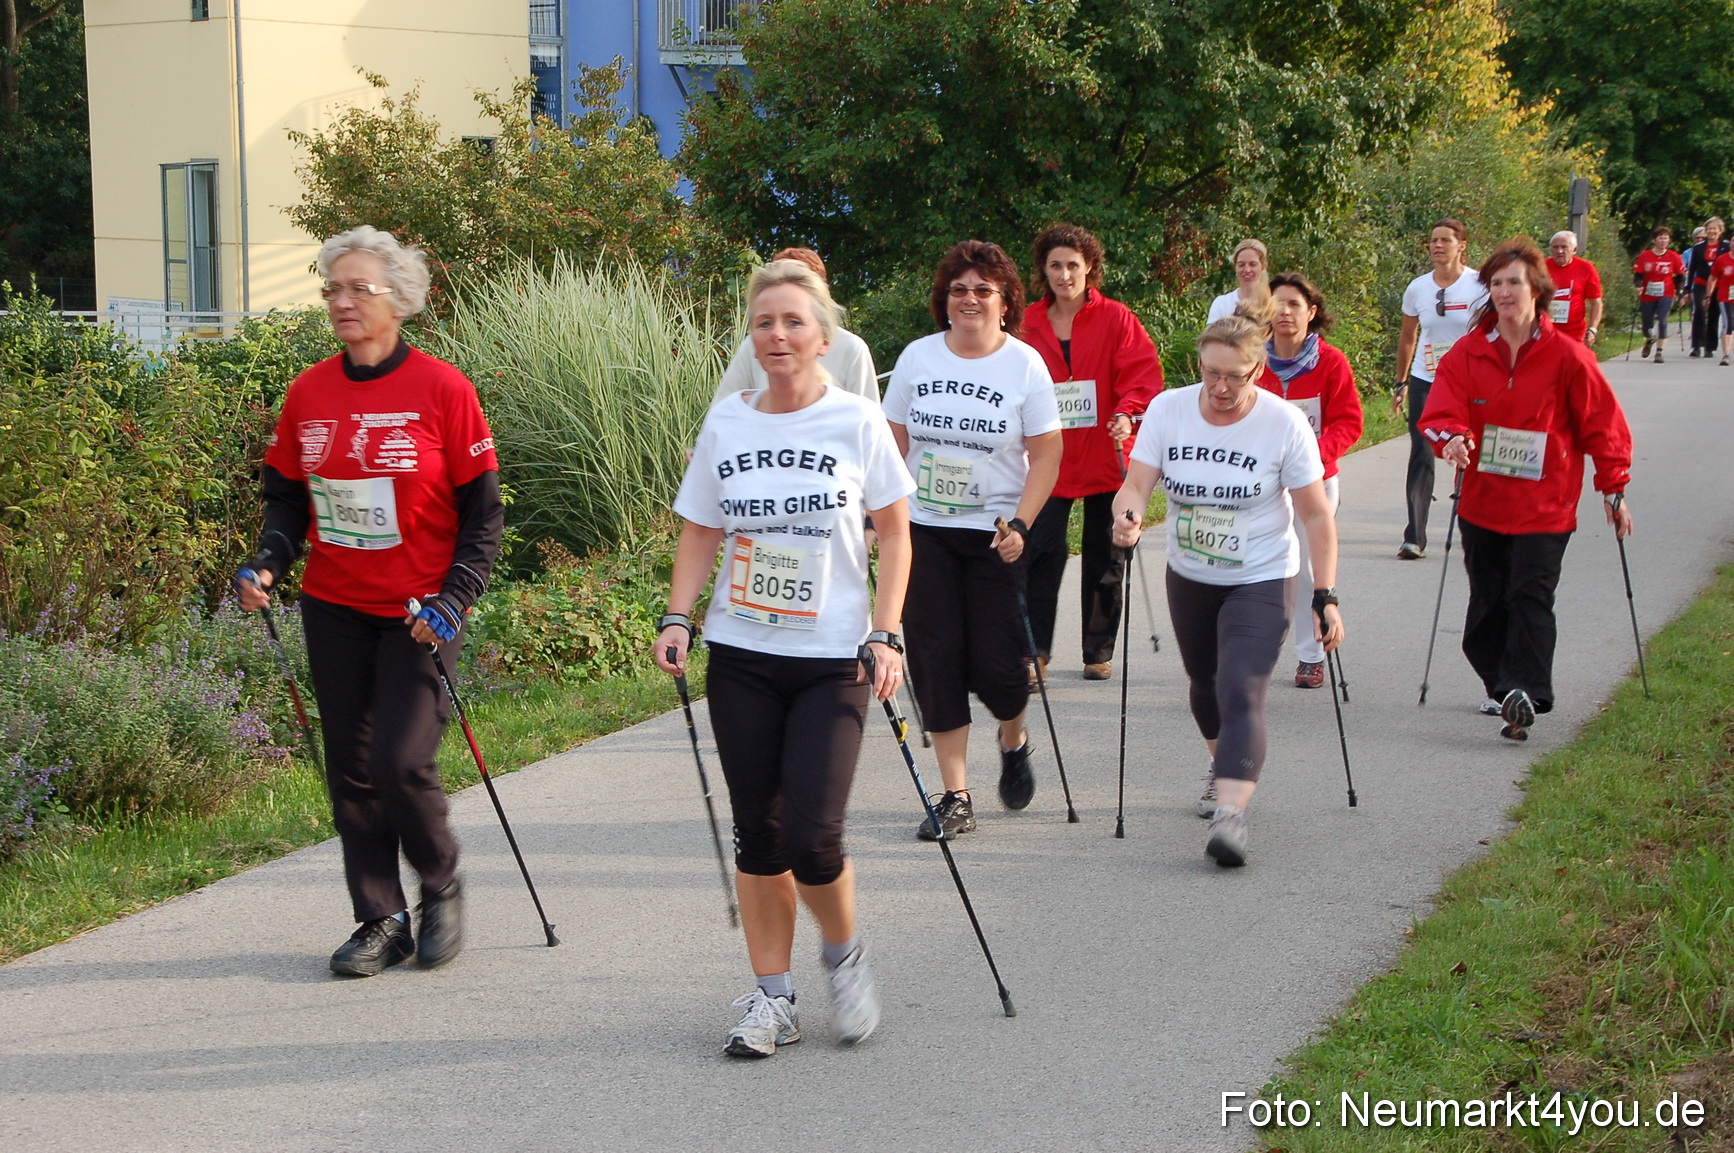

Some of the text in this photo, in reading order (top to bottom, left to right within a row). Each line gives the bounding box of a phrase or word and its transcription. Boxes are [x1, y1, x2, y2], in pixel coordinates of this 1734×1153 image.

[917, 379, 1004, 409] BERGER
[959, 417, 1007, 434] GIRLS
[943, 439, 960, 448] and
[962, 440, 995, 455] talking
[1498, 446, 1540, 465] 8092
[717, 448, 838, 480] BERGER
[935, 461, 974, 477] Irmgard
[1167, 445, 1258, 473] BERGER
[934, 477, 981, 499] 8074
[1213, 481, 1262, 500] GIRLS
[335, 503, 388, 527] 8078
[718, 489, 848, 518] OWER GIRLS
[1195, 509, 1236, 528] Irmgard
[765, 525, 789, 534] and
[793, 525, 833, 539] talking
[1195, 528, 1241, 552] 8073
[754, 546, 799, 570] Brigitte
[752, 572, 813, 602] 8055
